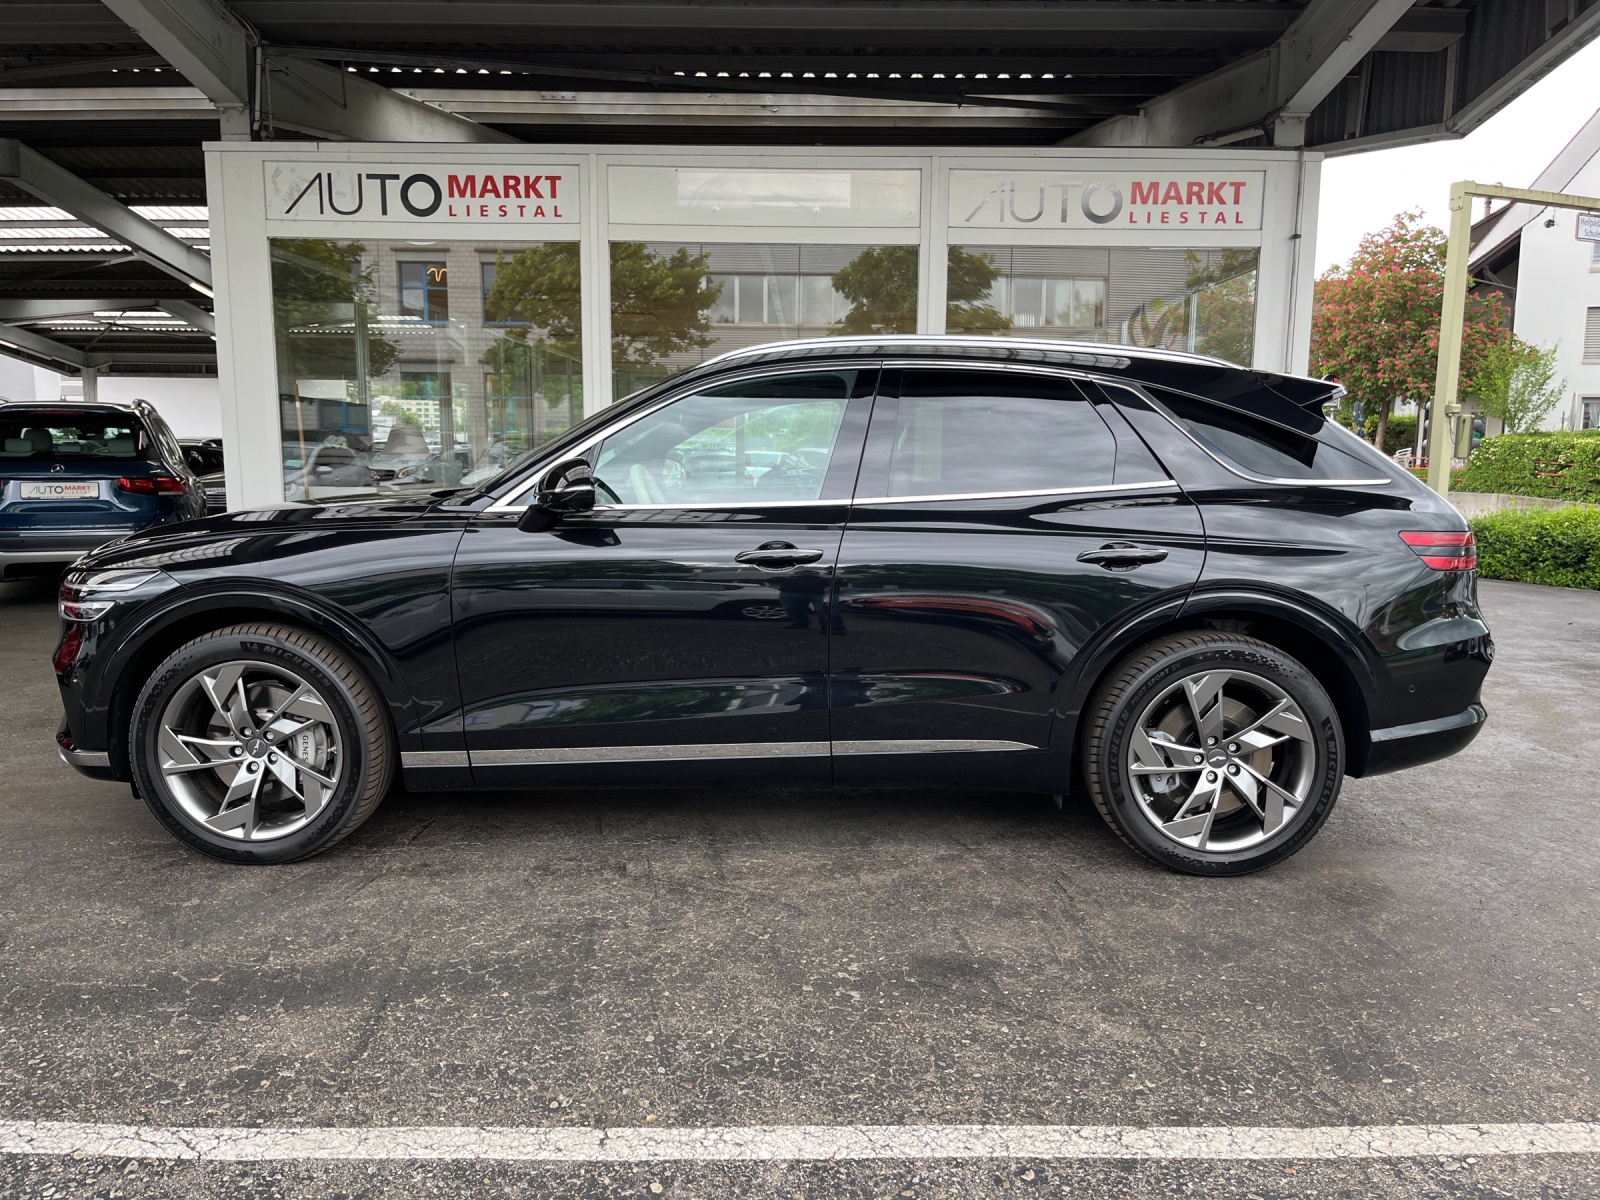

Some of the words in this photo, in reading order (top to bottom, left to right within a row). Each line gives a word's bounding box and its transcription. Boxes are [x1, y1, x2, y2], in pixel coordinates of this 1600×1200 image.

[284, 172, 442, 217] AUTO
[447, 174, 562, 199] MARKT
[448, 204, 562, 218] LIESTAL
[964, 180, 1123, 224] AUTO
[1130, 181, 1246, 206] MARKT
[1129, 211, 1243, 224] LIESTAL
[29, 486, 64, 494] AUTO
[262, 644, 332, 688] MICHELIN
[1109, 709, 1131, 784] MICHELIN
[1130, 685, 1147, 707] PILOT
[1147, 667, 1170, 687] SPORT
[1315, 739, 1337, 815] MICHELIN
